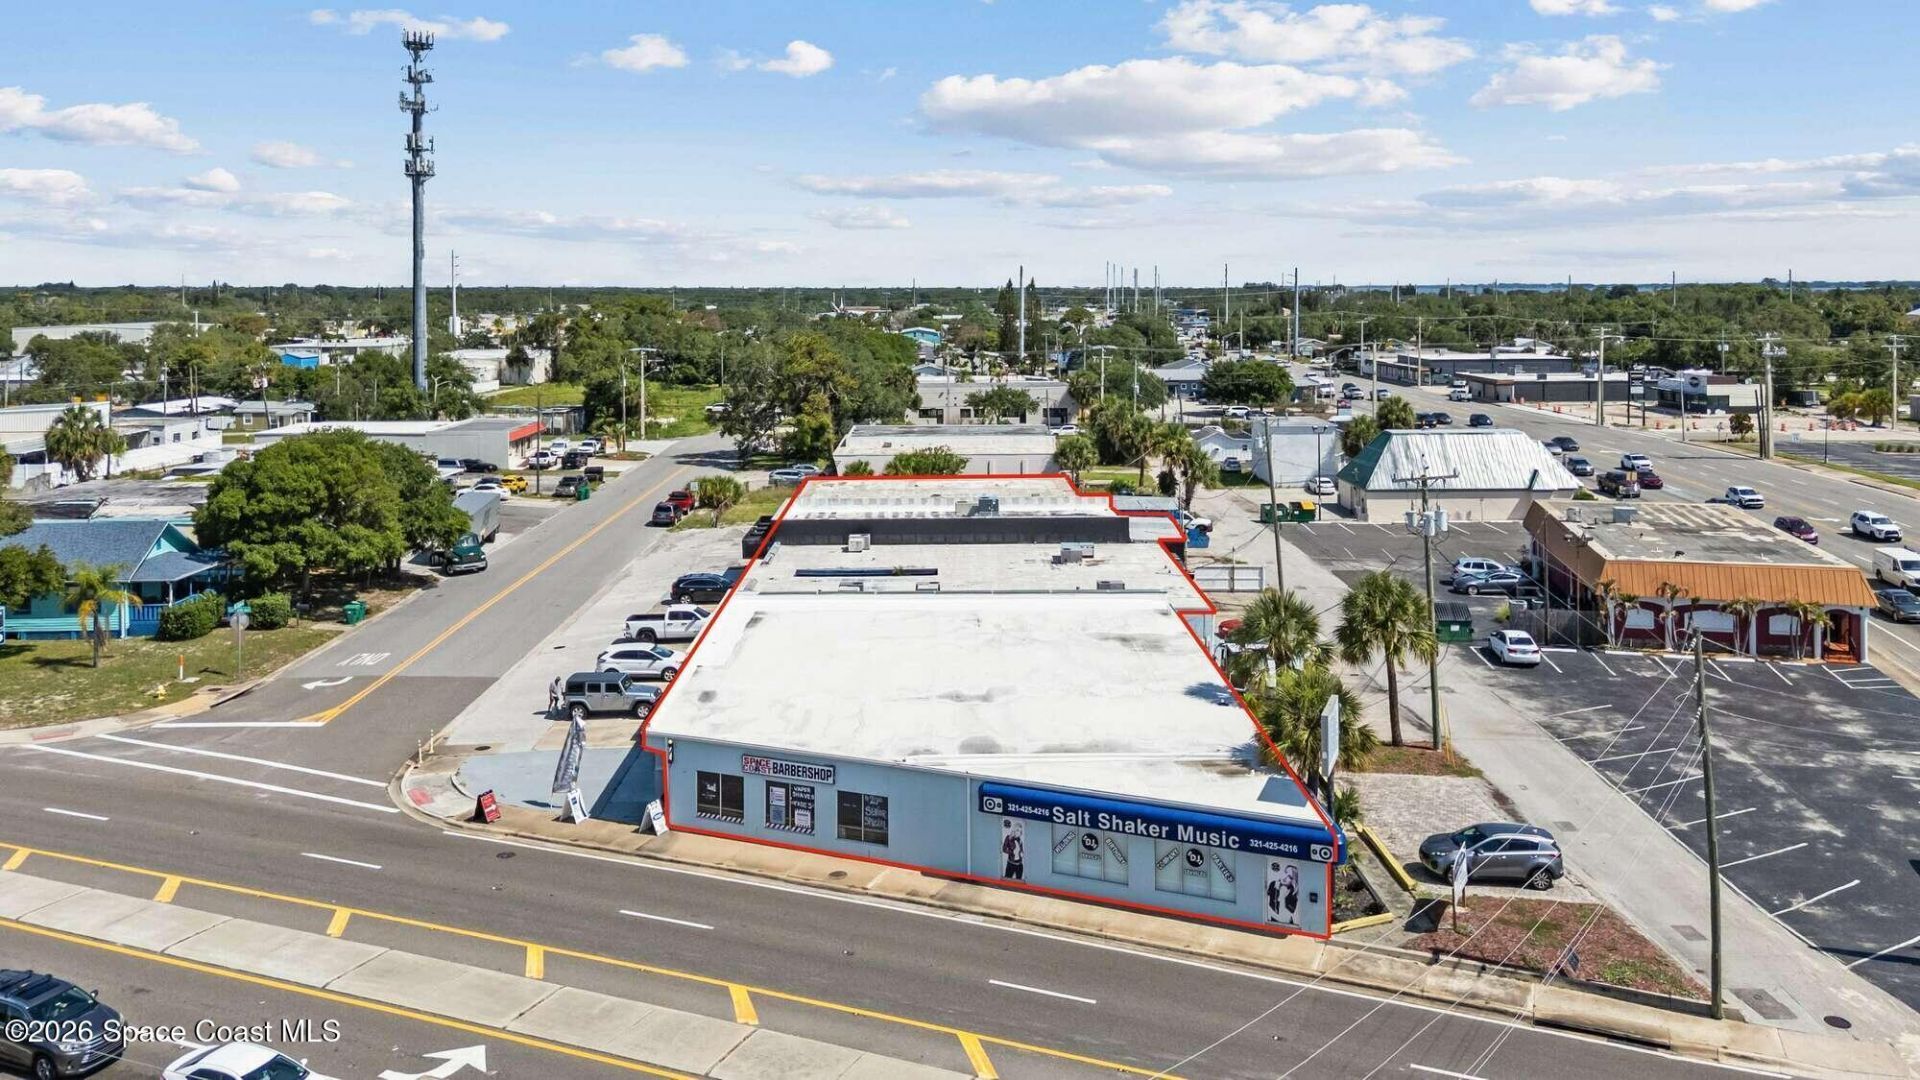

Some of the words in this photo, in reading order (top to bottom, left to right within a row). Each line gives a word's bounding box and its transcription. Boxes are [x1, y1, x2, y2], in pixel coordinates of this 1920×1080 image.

[742, 764, 771, 775] COAST
[772, 762, 832, 782] BARBERSHOP
[1007, 803, 1050, 816] 321-425-4216
[1052, 806, 1090, 827] Salt
[1098, 813, 1169, 838] Shaker
[1177, 824, 1240, 848] Music
[1249, 838, 1298, 853] 321-425-4216
